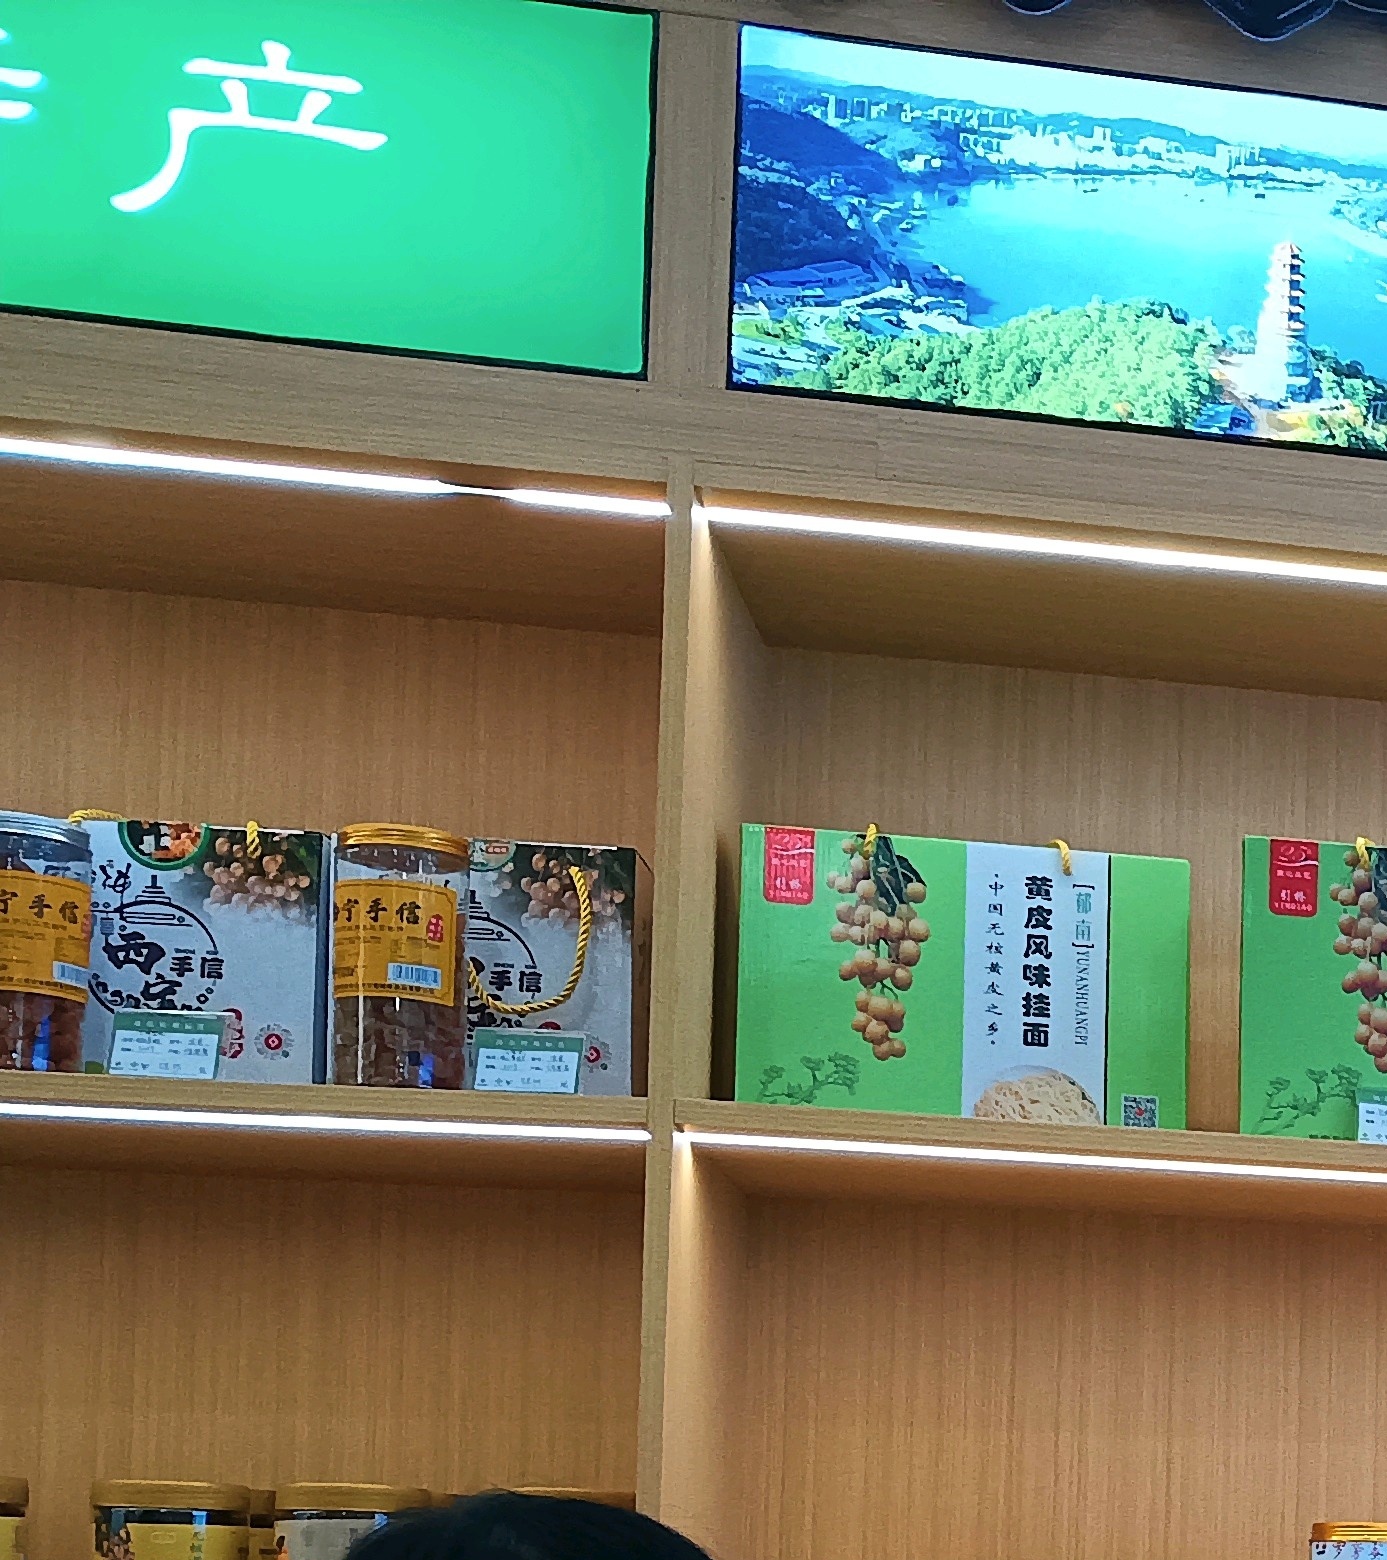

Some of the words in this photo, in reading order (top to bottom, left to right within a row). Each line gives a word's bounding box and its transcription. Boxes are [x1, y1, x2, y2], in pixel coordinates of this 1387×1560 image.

[169, 955, 225, 980] 手信
[1022, 875, 1054, 1048] 黄皮风味挂面
[489, 968, 542, 993] 手信
